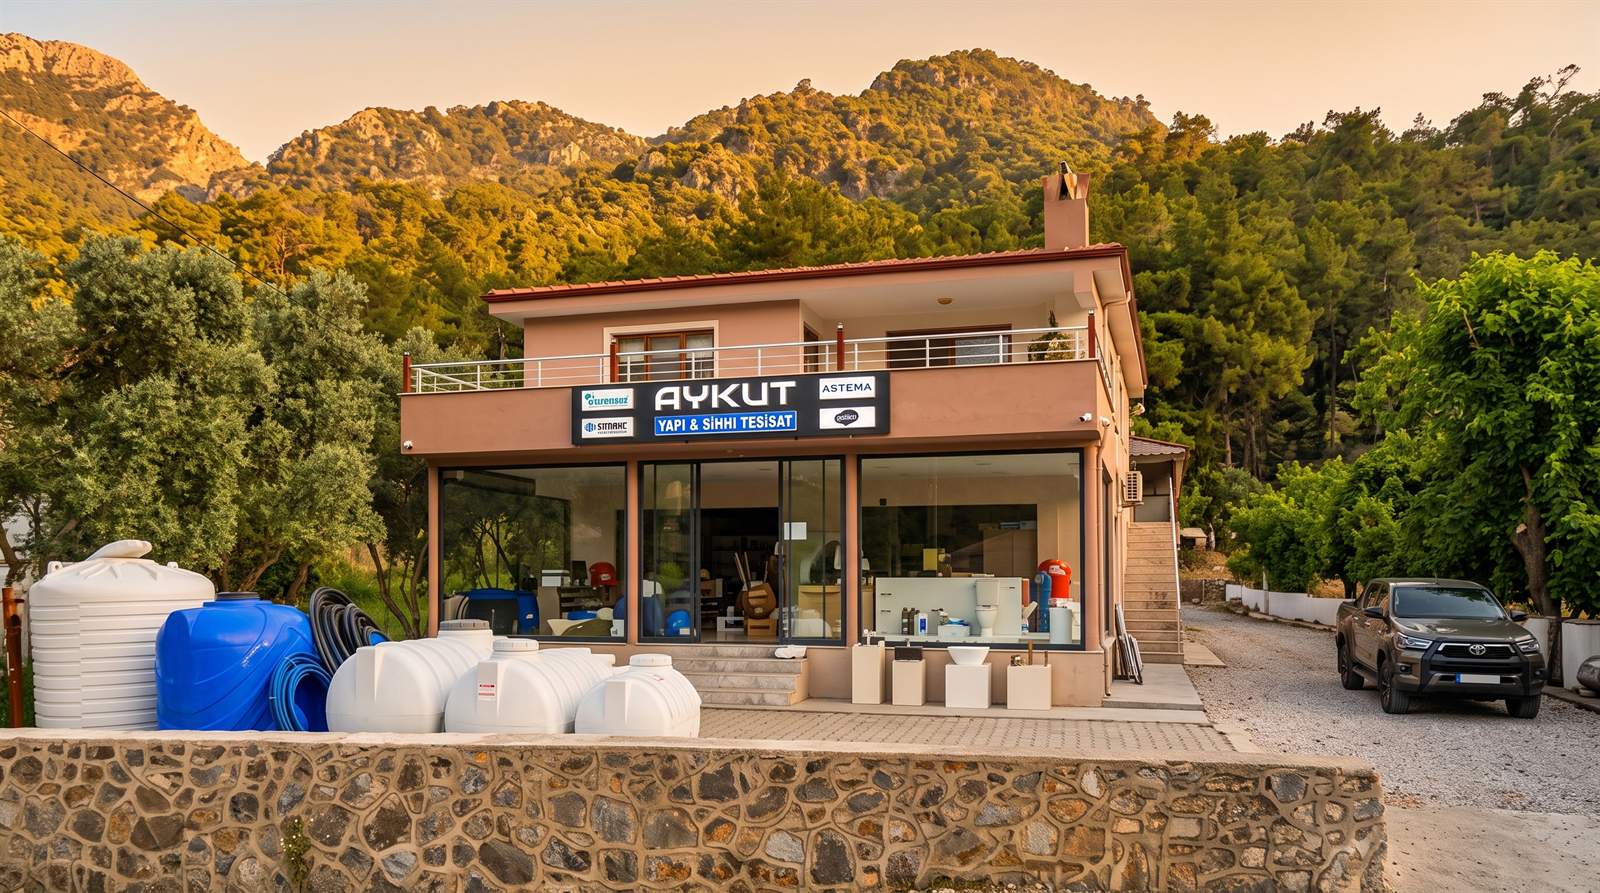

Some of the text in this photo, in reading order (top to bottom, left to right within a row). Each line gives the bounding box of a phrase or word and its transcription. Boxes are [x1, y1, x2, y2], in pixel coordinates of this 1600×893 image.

[822, 383, 872, 393] ASTEMA
[655, 381, 797, 411] AYKUT
[658, 418, 686, 432] YAPI
[689, 418, 699, 431] &
